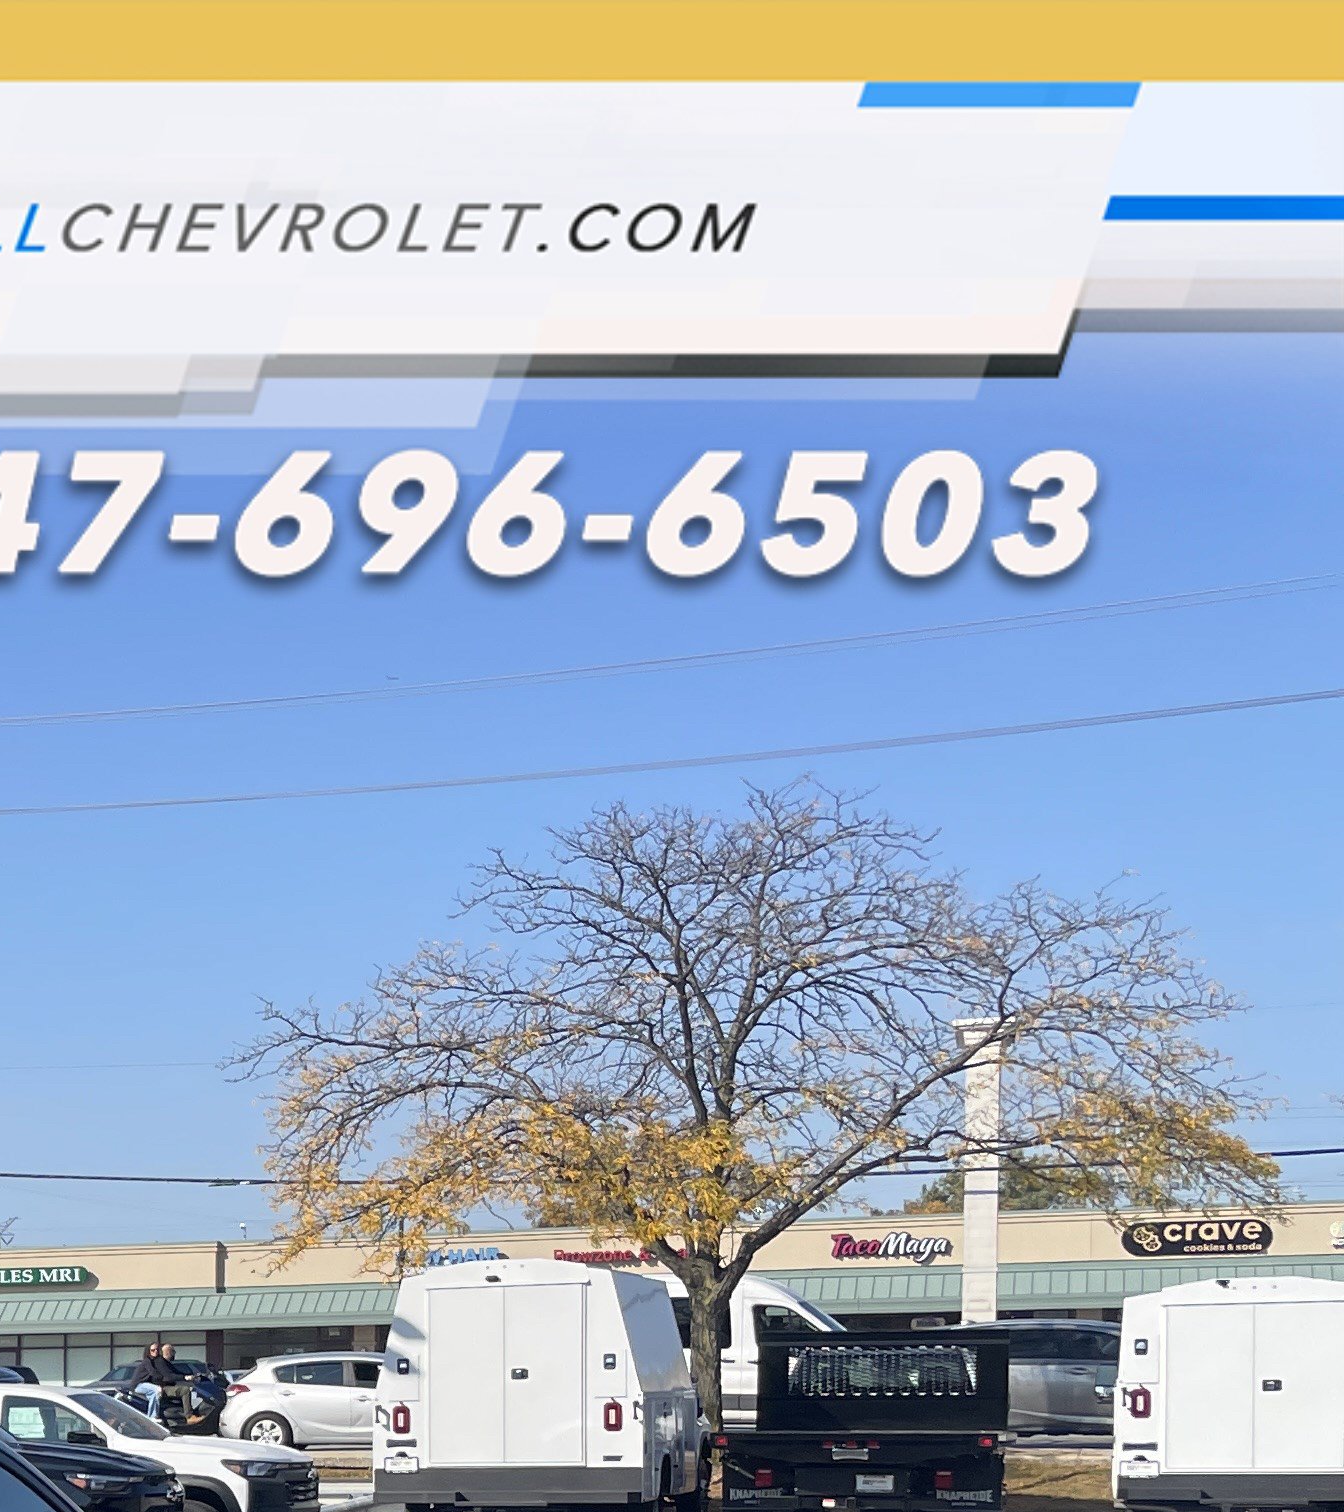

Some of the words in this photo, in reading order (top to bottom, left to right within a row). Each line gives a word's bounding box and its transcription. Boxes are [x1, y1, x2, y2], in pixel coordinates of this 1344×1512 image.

[1163, 1222, 1262, 1242] crave
[1184, 1244, 1225, 1252] cookies
[1236, 1243, 1263, 1251] soda
[39, 1268, 81, 1282] MRI
